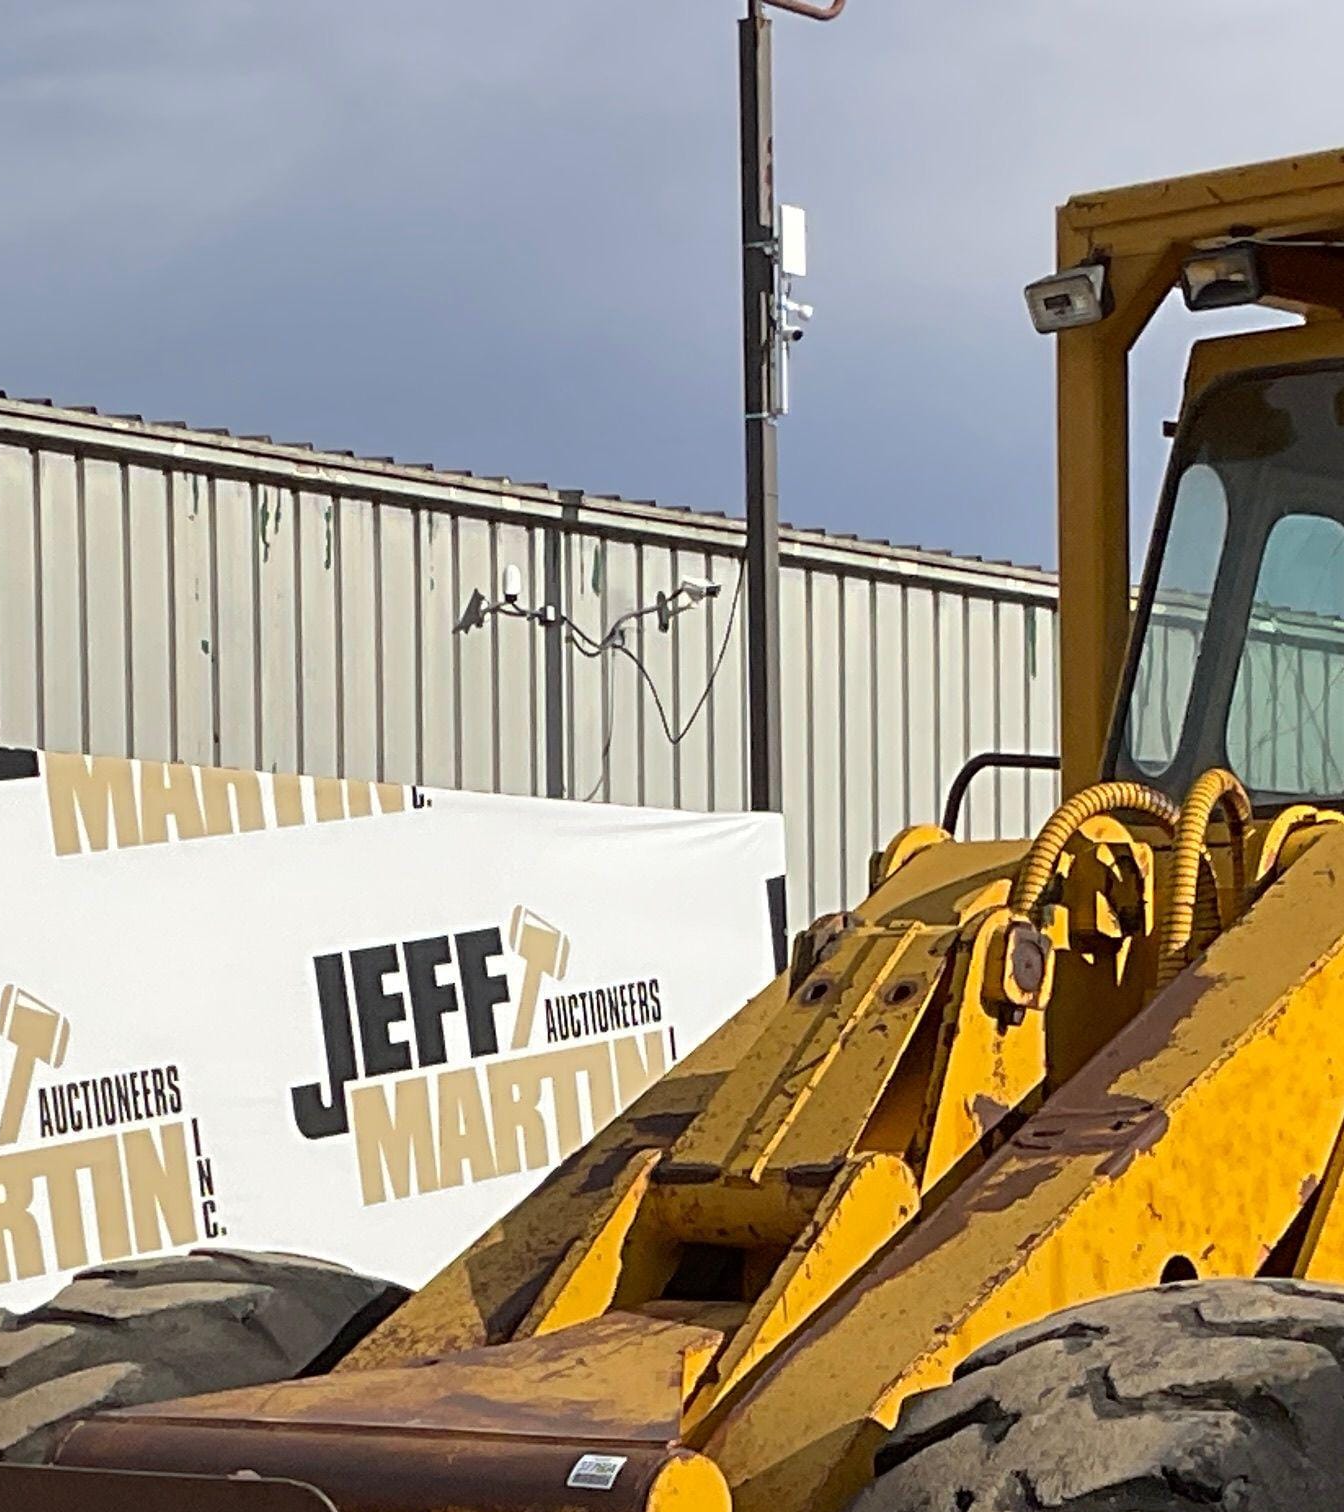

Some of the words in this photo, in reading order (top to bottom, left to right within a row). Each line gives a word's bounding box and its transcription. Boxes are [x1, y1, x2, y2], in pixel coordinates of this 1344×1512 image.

[291, 926, 511, 1140] JEFF
[543, 978, 662, 1044] AUCTIONEERS
[37, 1065, 183, 1138] AUCTIONEERS
[191, 1117, 228, 1239] INC.
